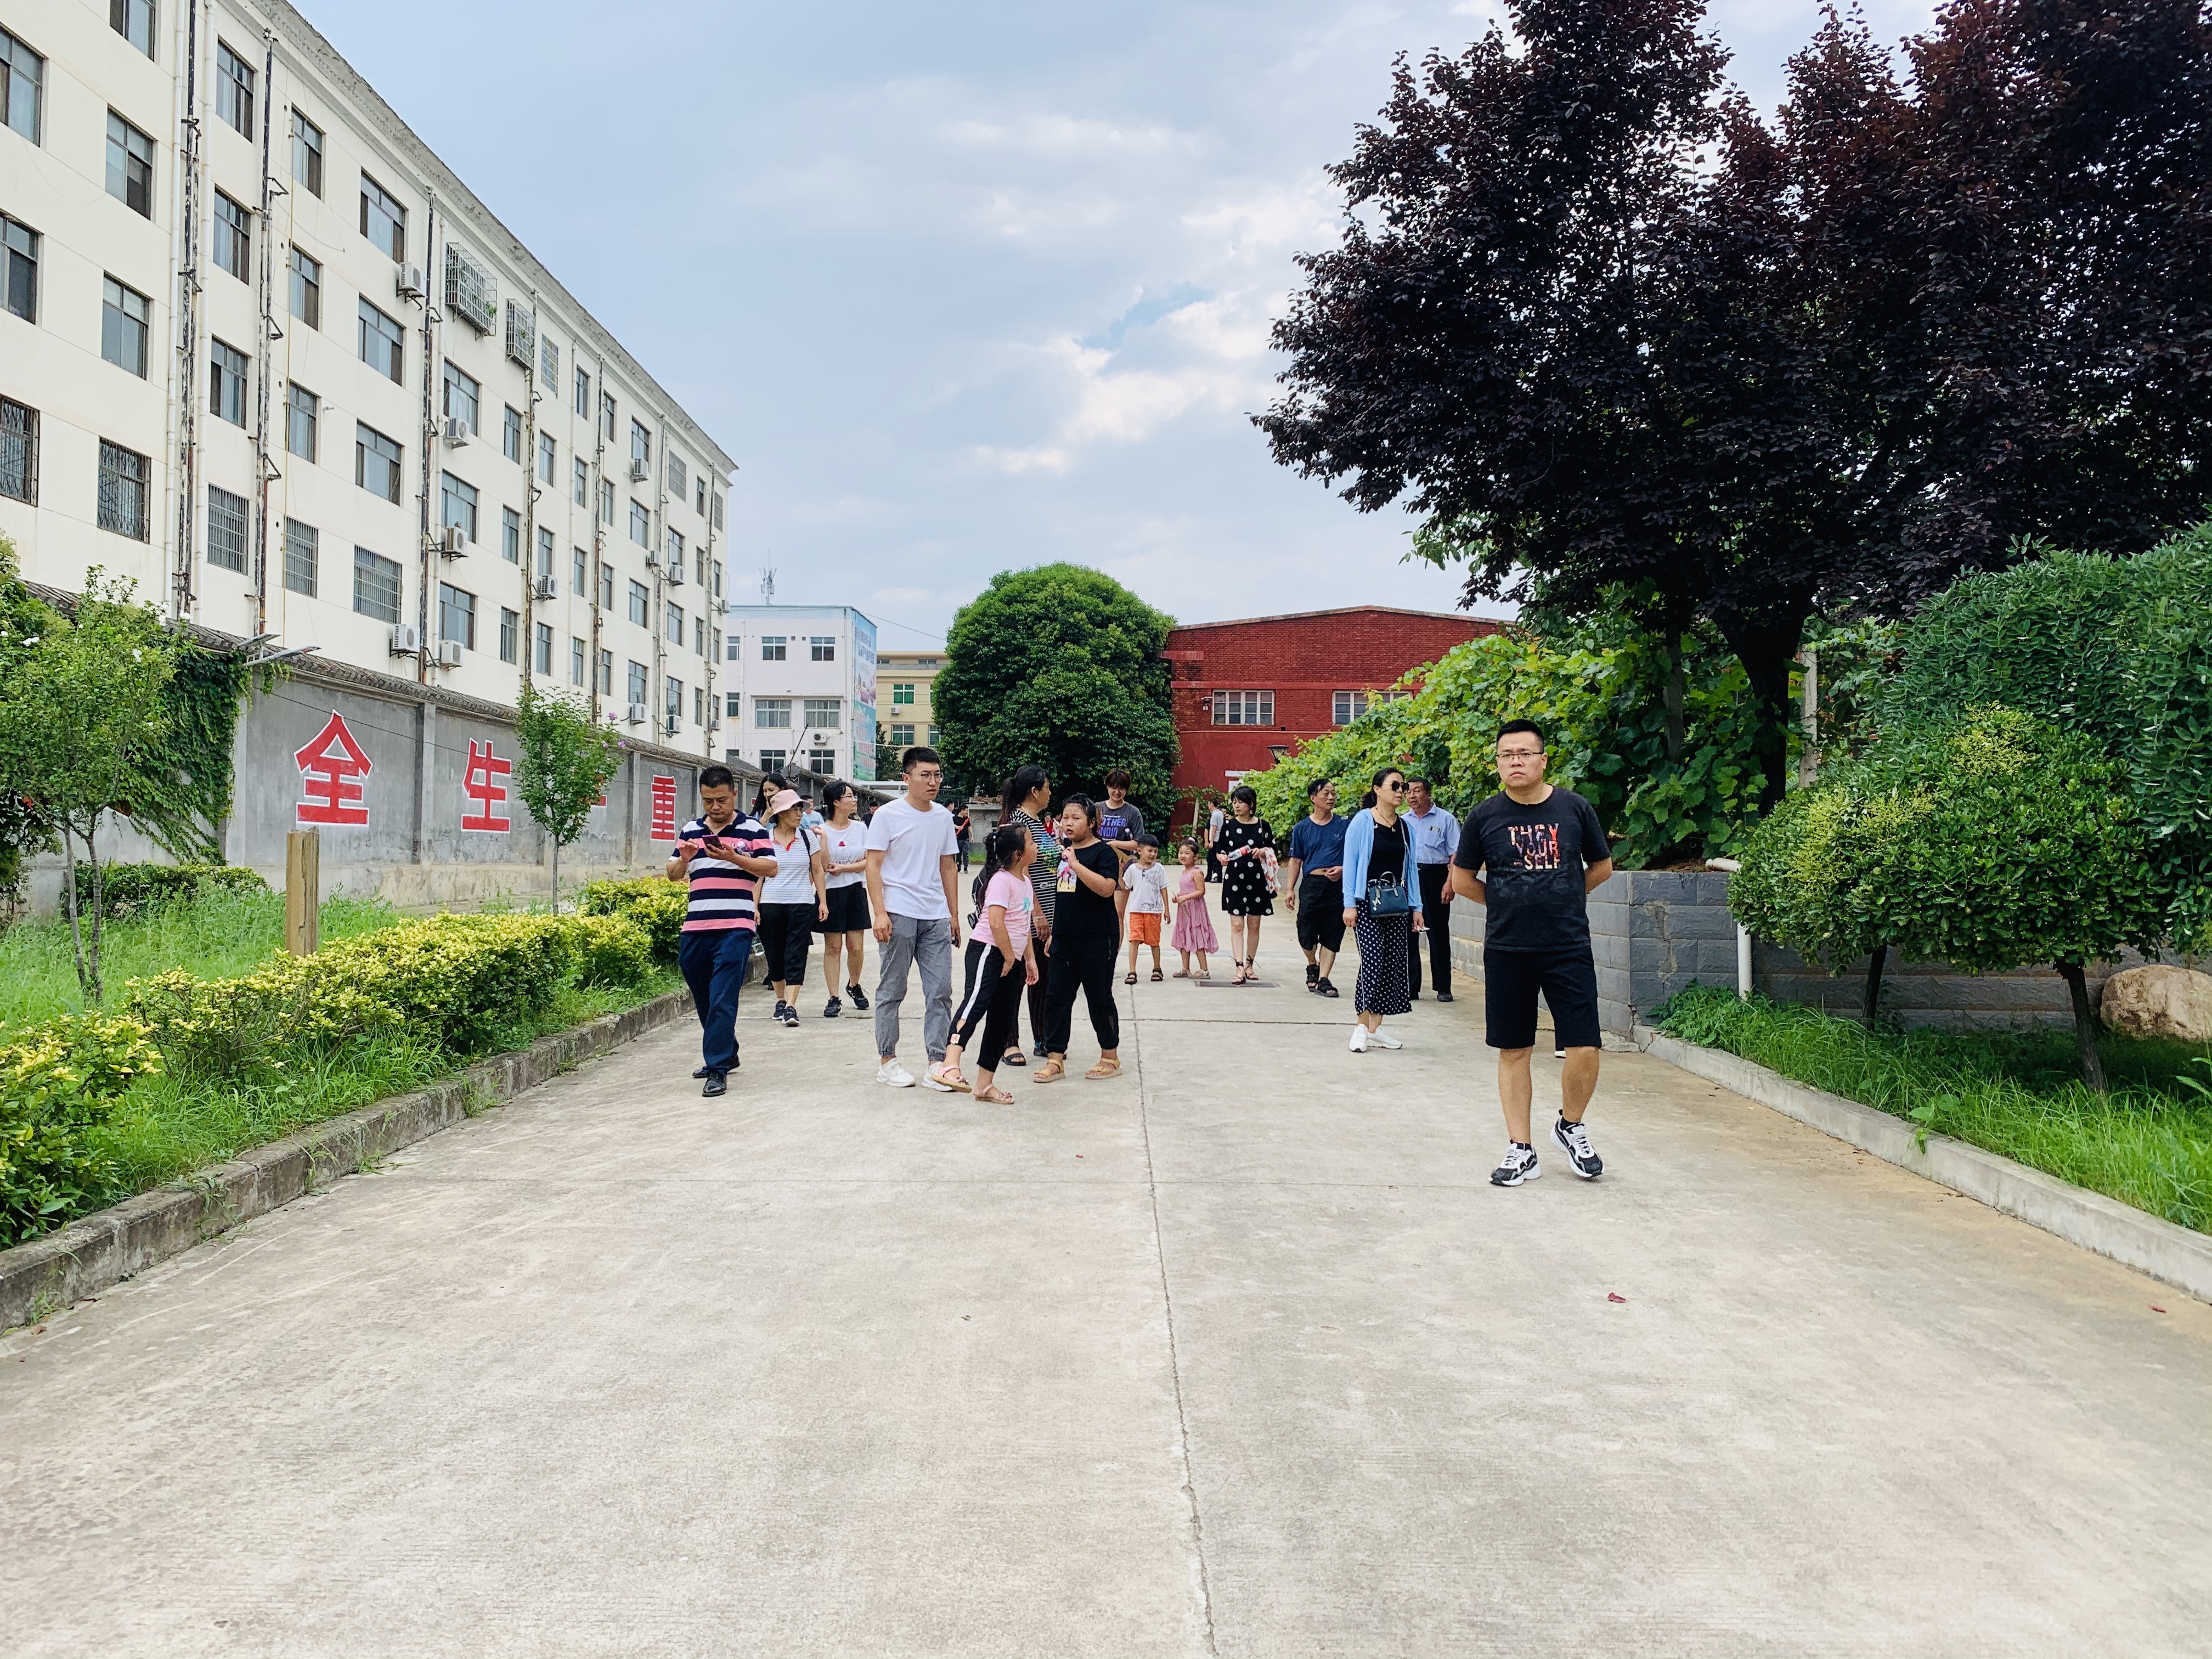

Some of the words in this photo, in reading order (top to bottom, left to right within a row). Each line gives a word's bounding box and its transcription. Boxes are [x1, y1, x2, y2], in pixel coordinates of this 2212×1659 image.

[293, 708, 374, 826] 全
[461, 737, 512, 834] 生
[650, 774, 677, 842] 重
[1516, 839, 1559, 857] YOUR
